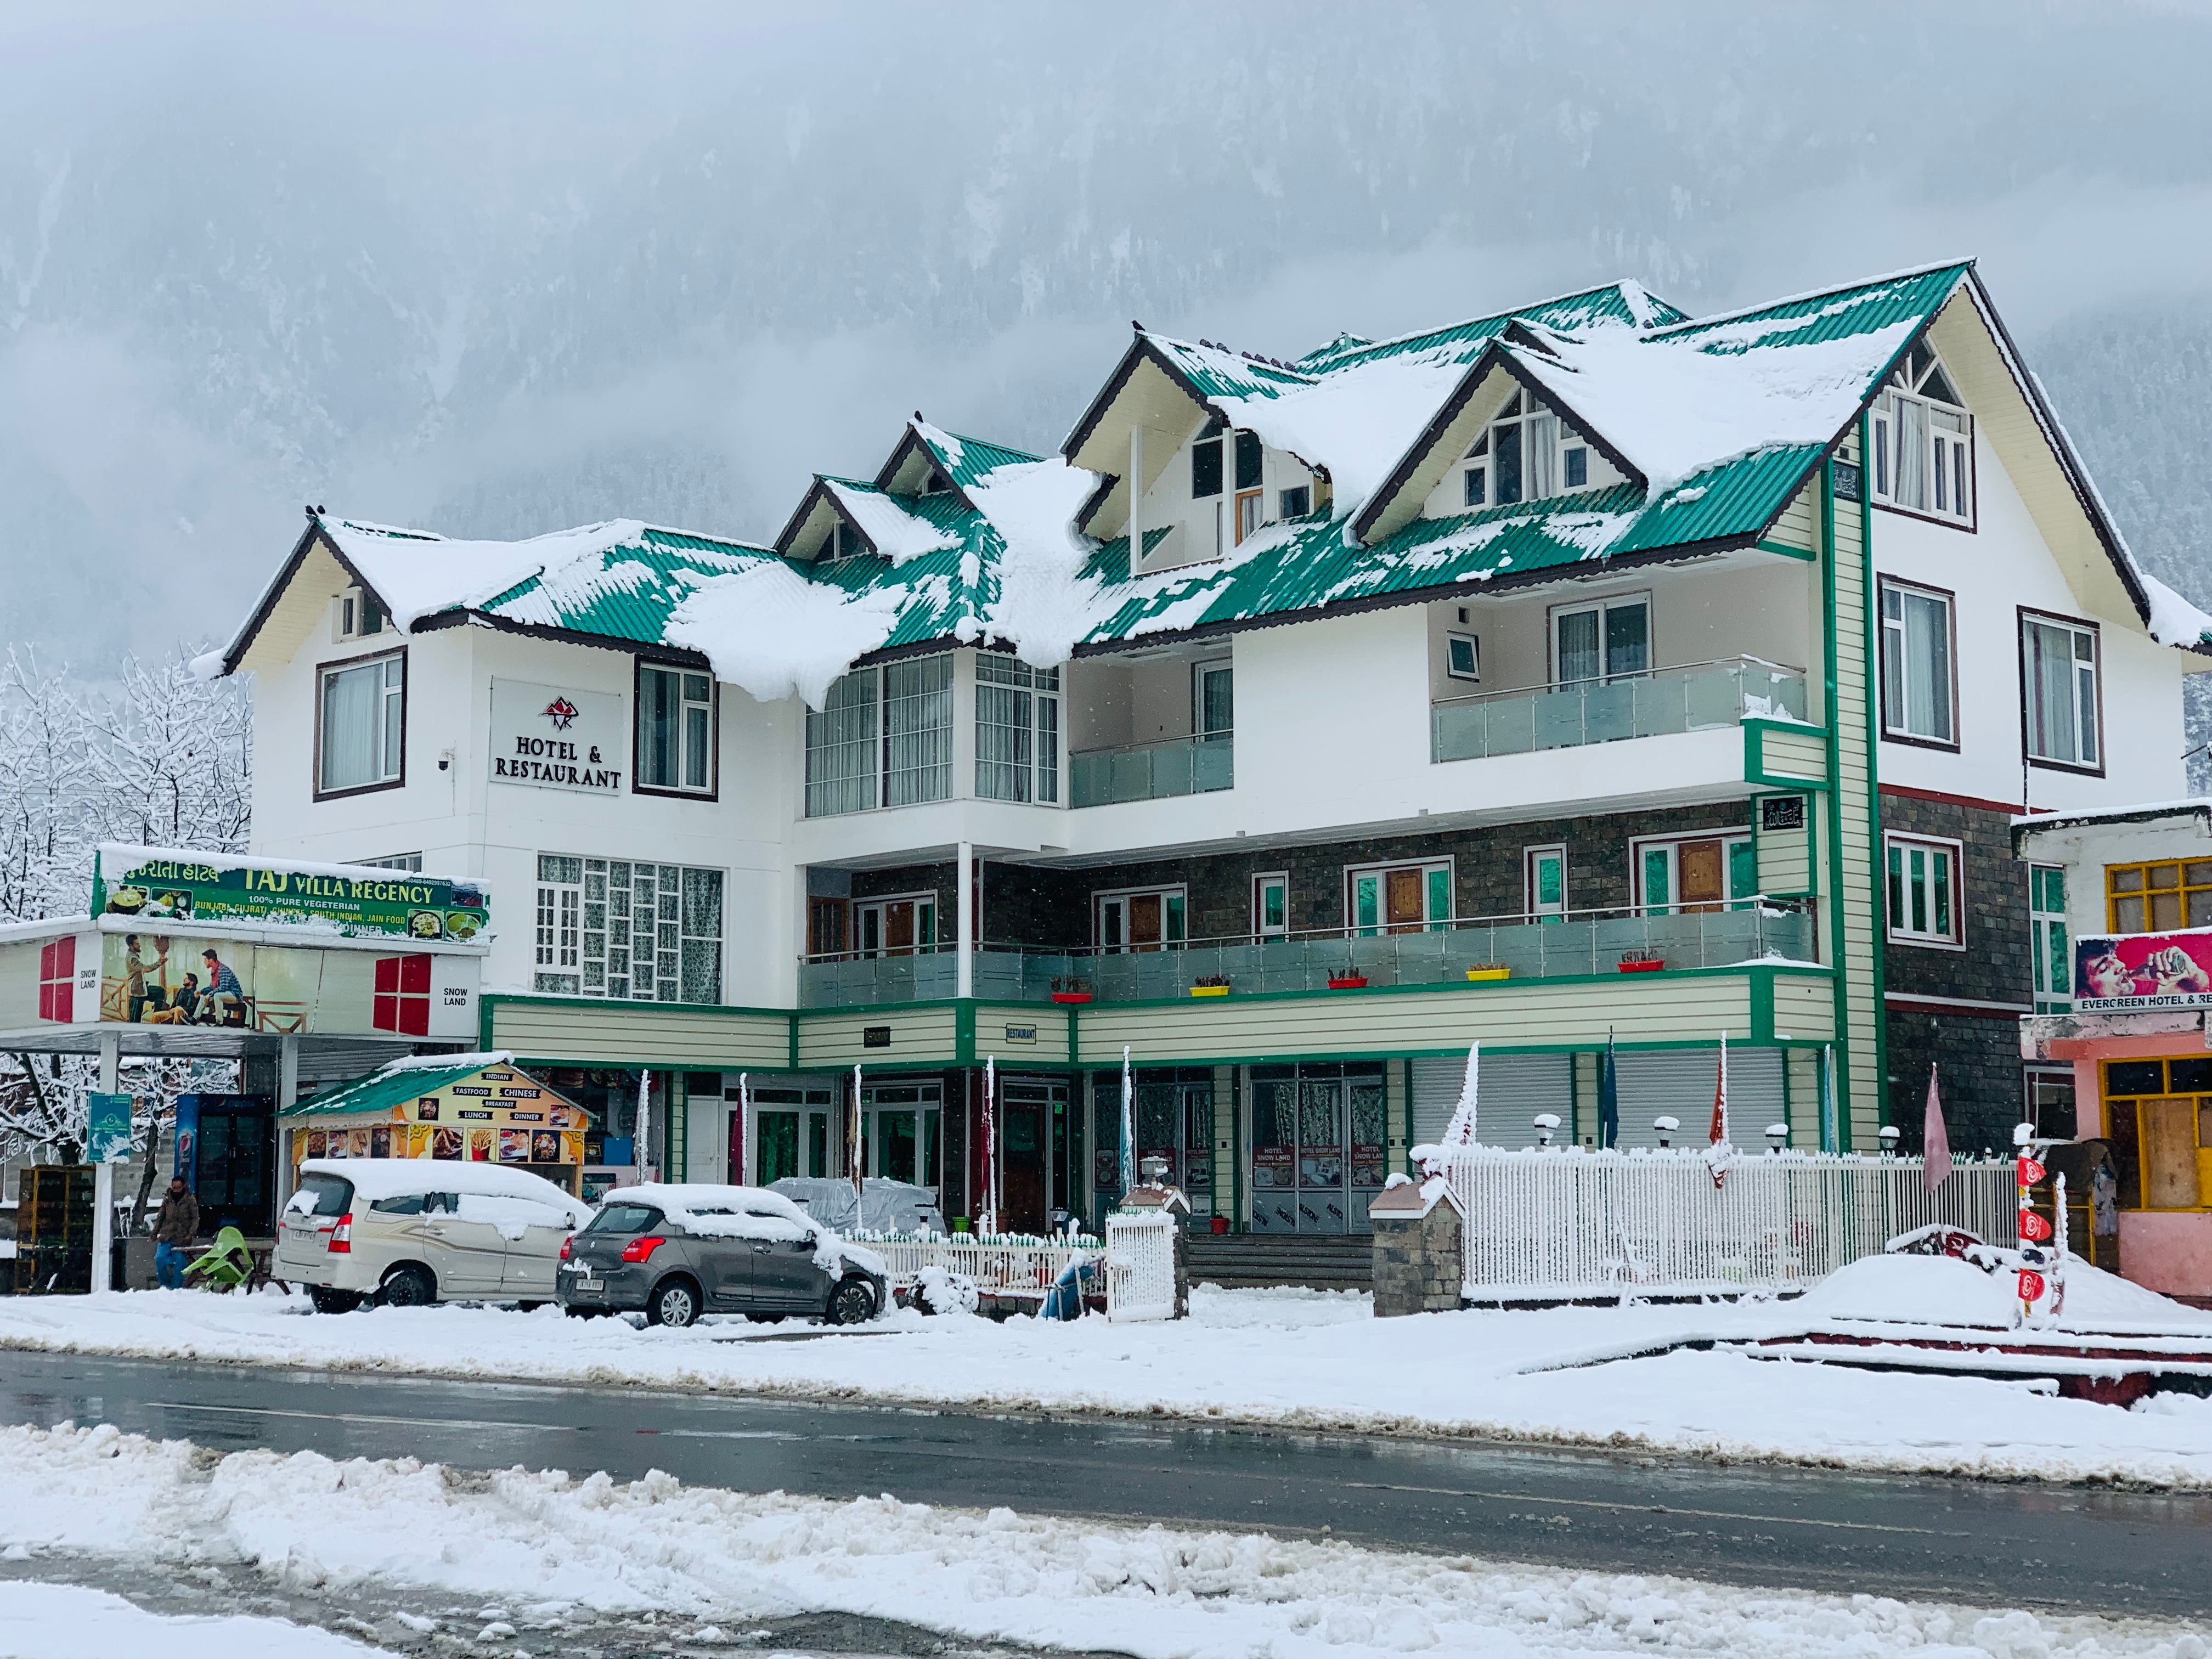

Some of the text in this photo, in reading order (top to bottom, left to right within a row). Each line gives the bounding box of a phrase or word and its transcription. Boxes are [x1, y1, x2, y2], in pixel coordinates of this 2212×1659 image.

[516, 736, 602, 763] HOTEL &
[495, 758, 621, 788] RESTAURANT
[295, 877, 345, 896] VILLA
[351, 882, 433, 904] REGENCY
[249, 895, 360, 911] 100% PURE VEGETERIAN
[367, 915, 383, 923] JAIN
[386, 916, 405, 924] FOOD
[81, 969, 97, 979] SNOW
[81, 980, 95, 989] LAND
[444, 988, 467, 996] SNOW
[444, 997, 466, 1006] LAND
[2082, 997, 2145, 1009] EVERGREEN
[2149, 996, 2183, 1006] HOTEL
[2187, 995, 2194, 1004] &
[1006, 1028, 1035, 1039] RESTAURANT
[504, 1088, 537, 1098] CHINESE
